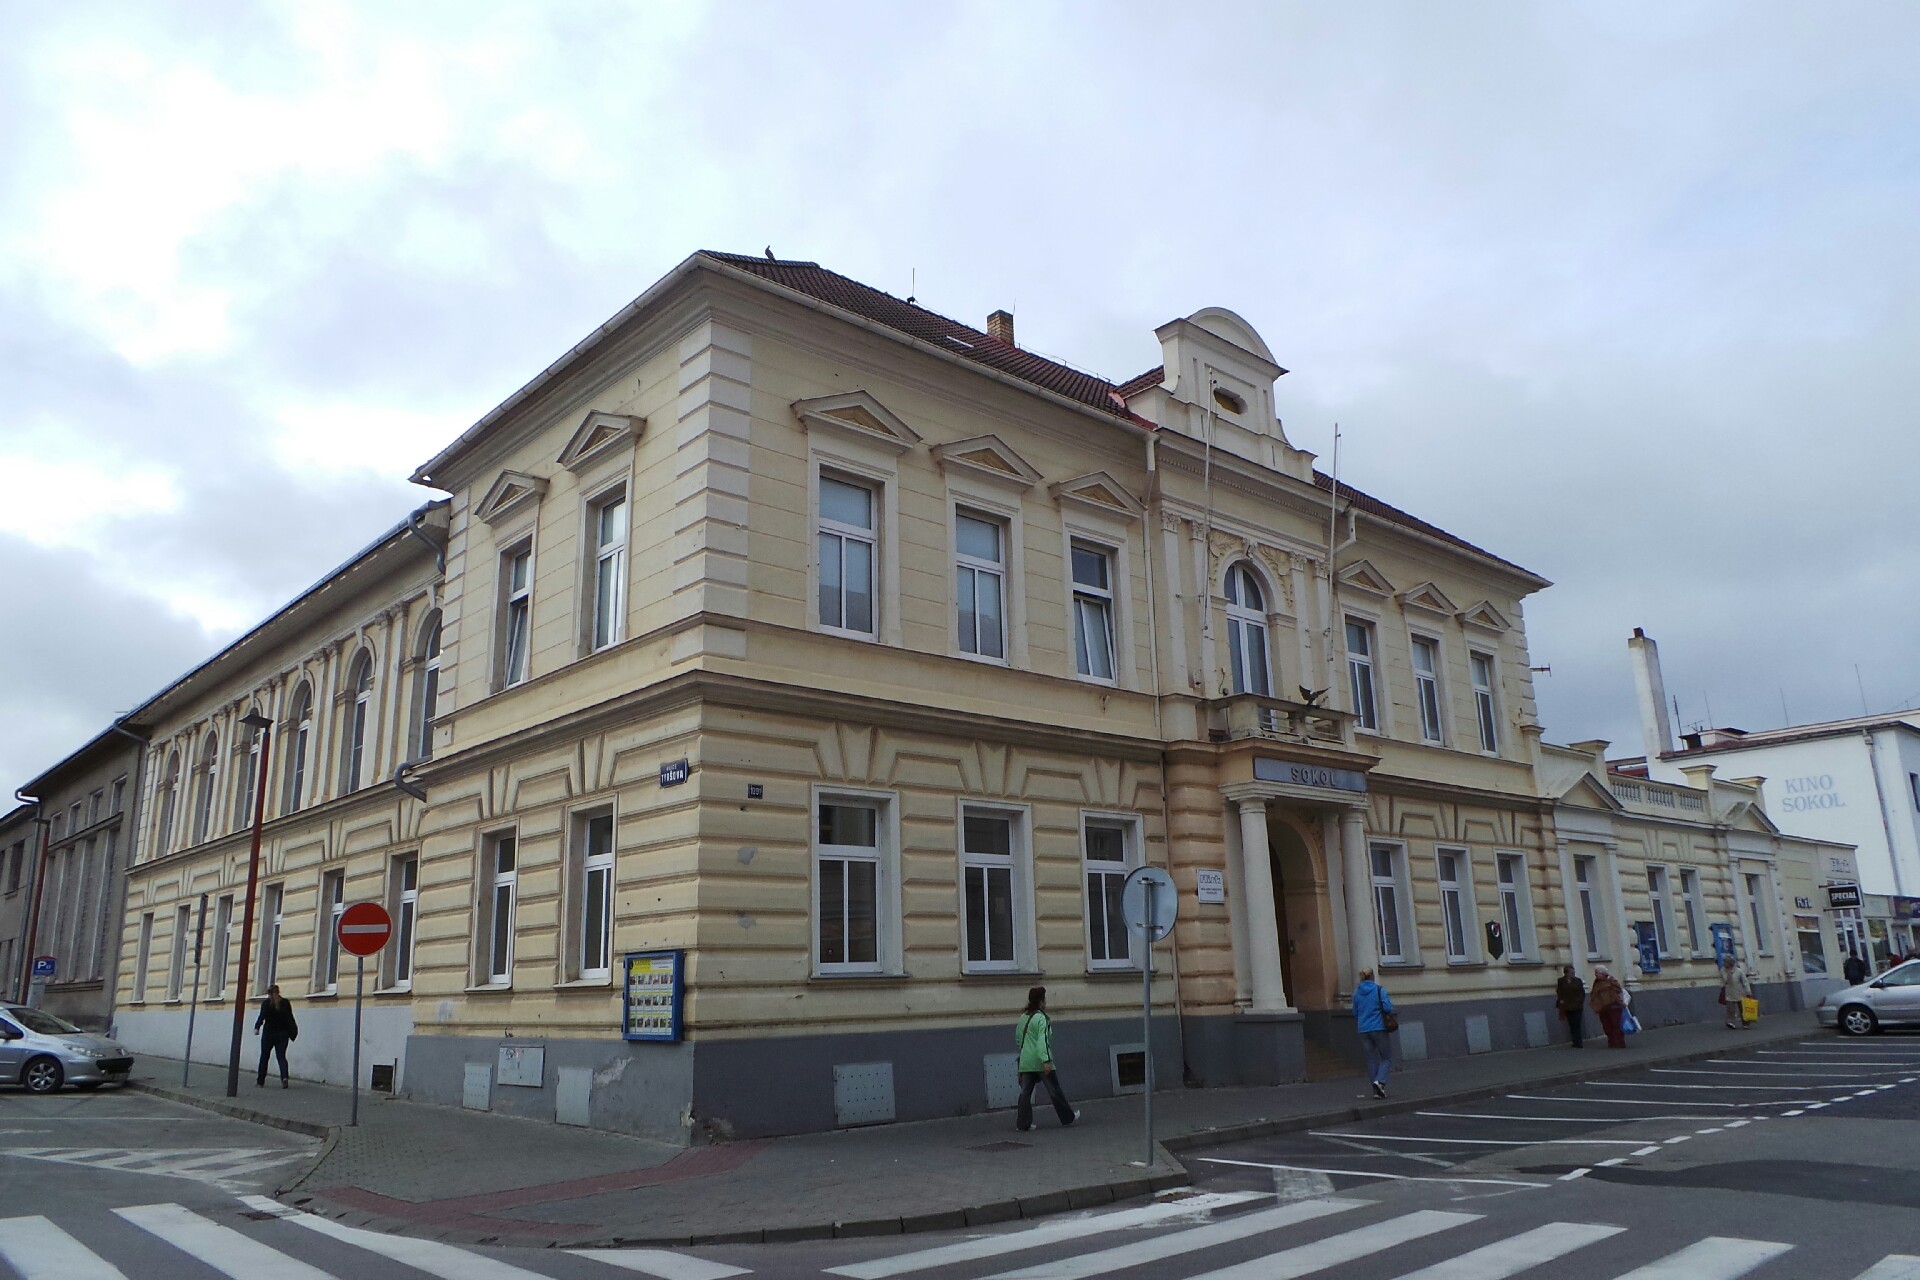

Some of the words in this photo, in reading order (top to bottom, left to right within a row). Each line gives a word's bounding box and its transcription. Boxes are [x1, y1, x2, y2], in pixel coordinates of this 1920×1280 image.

[661, 770, 684, 784] TYRŠOVA
[1291, 767, 1336, 787] SOKOL
[1785, 774, 1834, 794] KINO
[1782, 792, 1848, 813] SOKOL
[1831, 891, 1857, 901] SPECIAL
[37, 960, 47, 969] P
